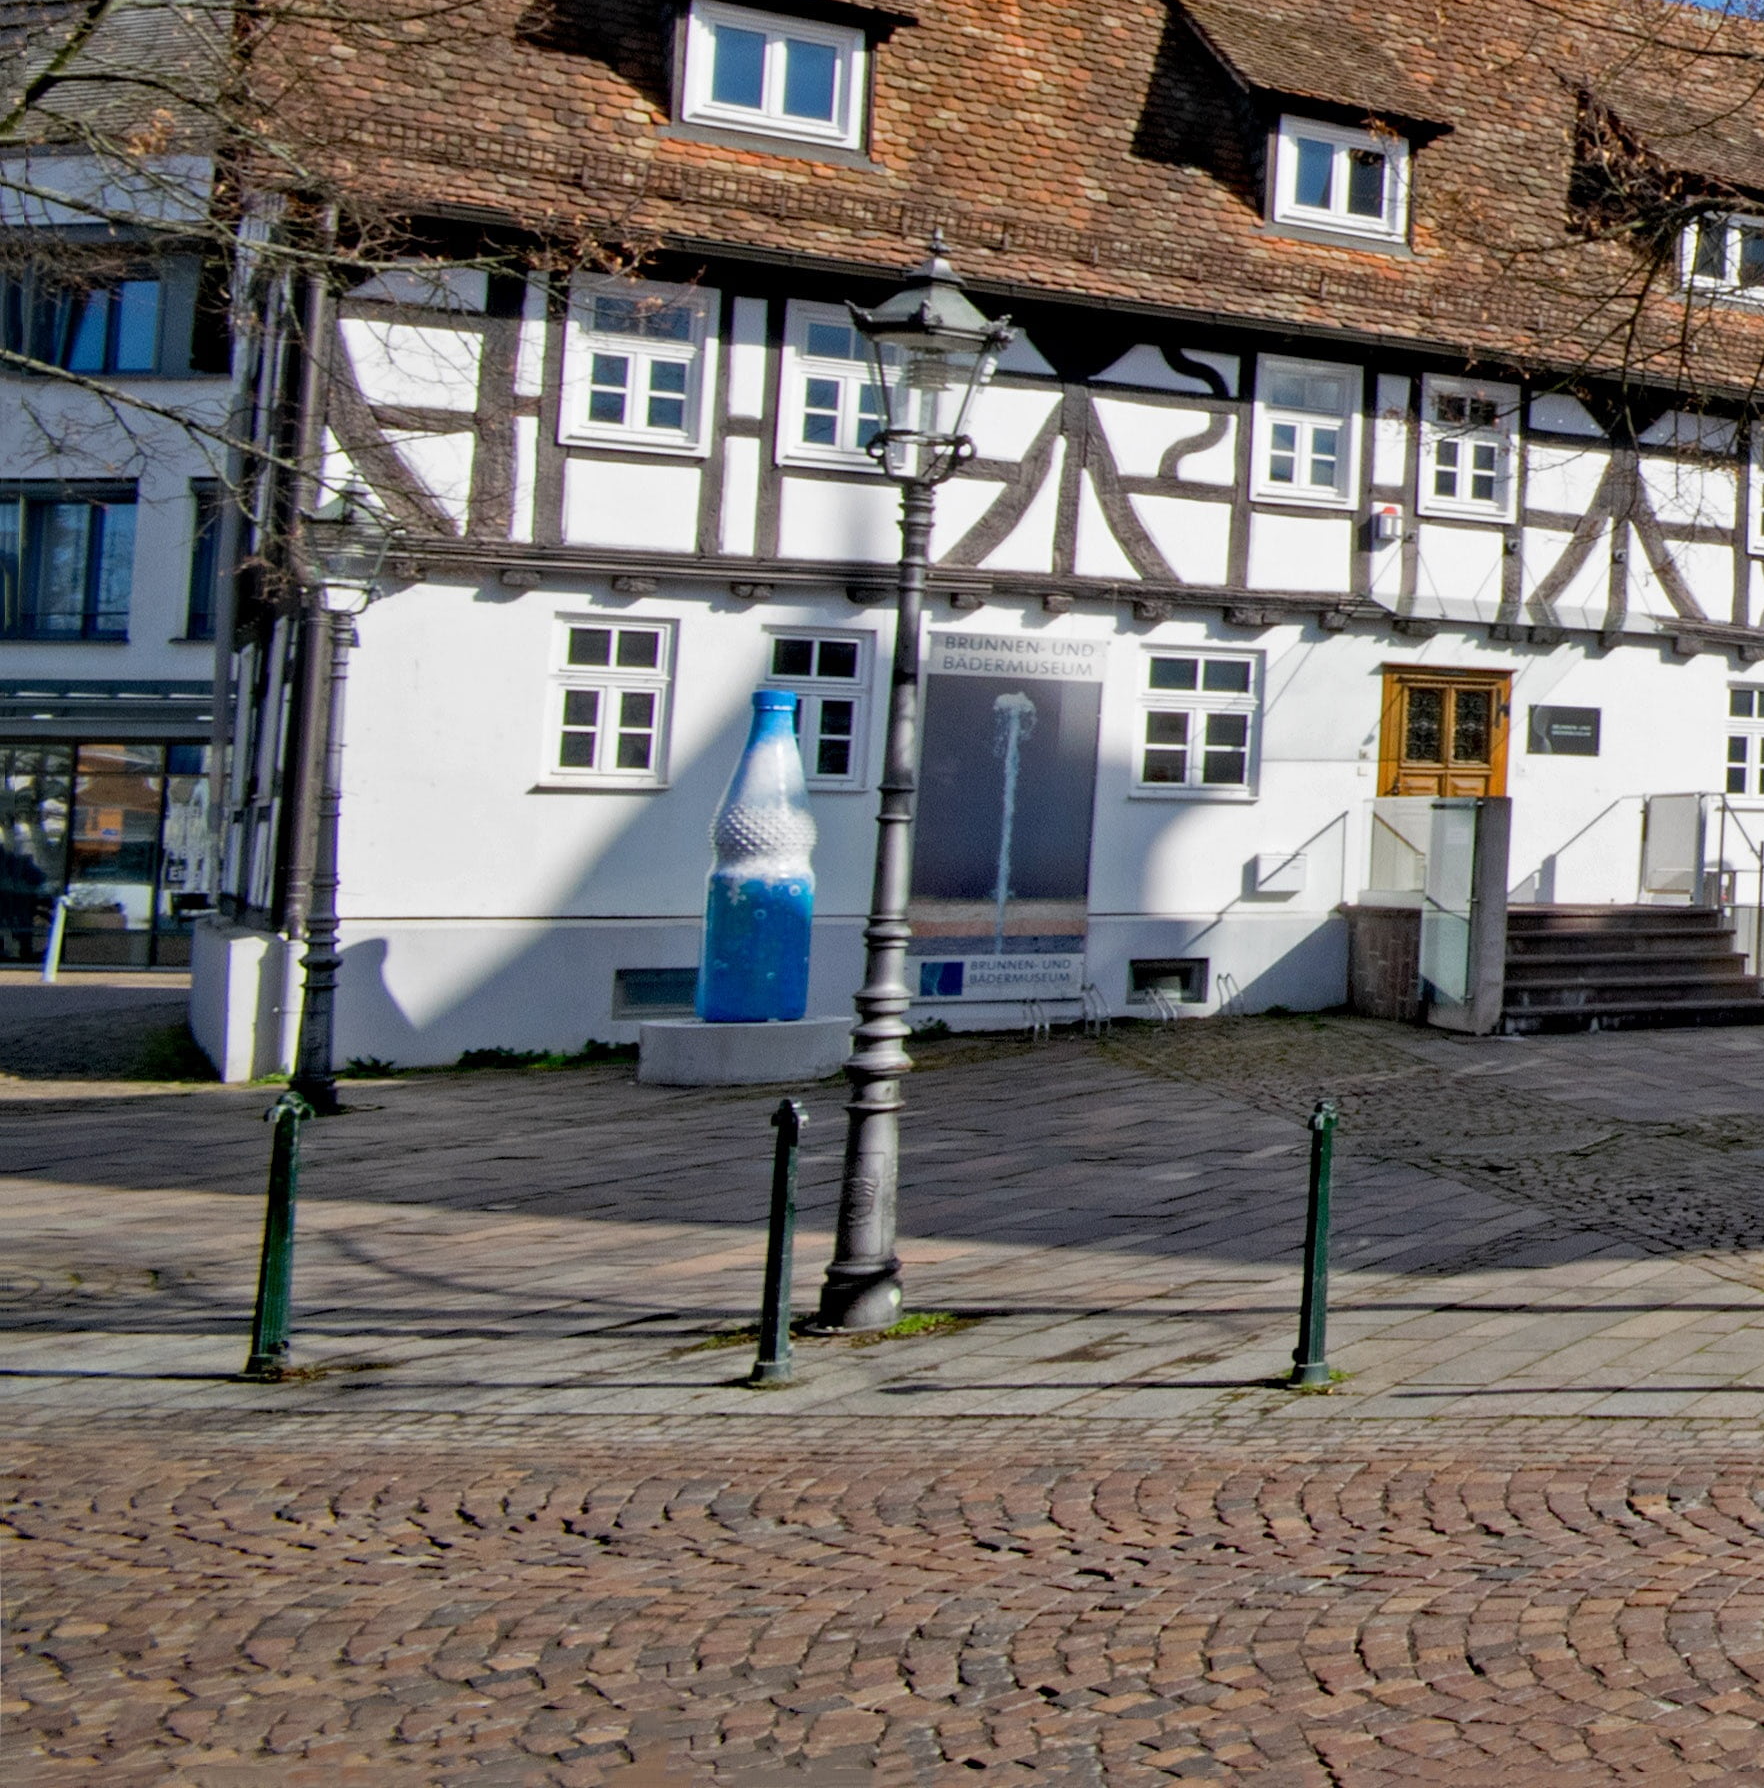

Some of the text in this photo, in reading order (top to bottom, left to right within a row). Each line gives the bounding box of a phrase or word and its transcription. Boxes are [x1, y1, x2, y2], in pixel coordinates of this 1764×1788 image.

[944, 636, 1095, 657] BRUNNEN- UND
[942, 655, 1093, 676] BÄDERMUSEUM
[970, 960, 1071, 971] BRUNNEN- UND
